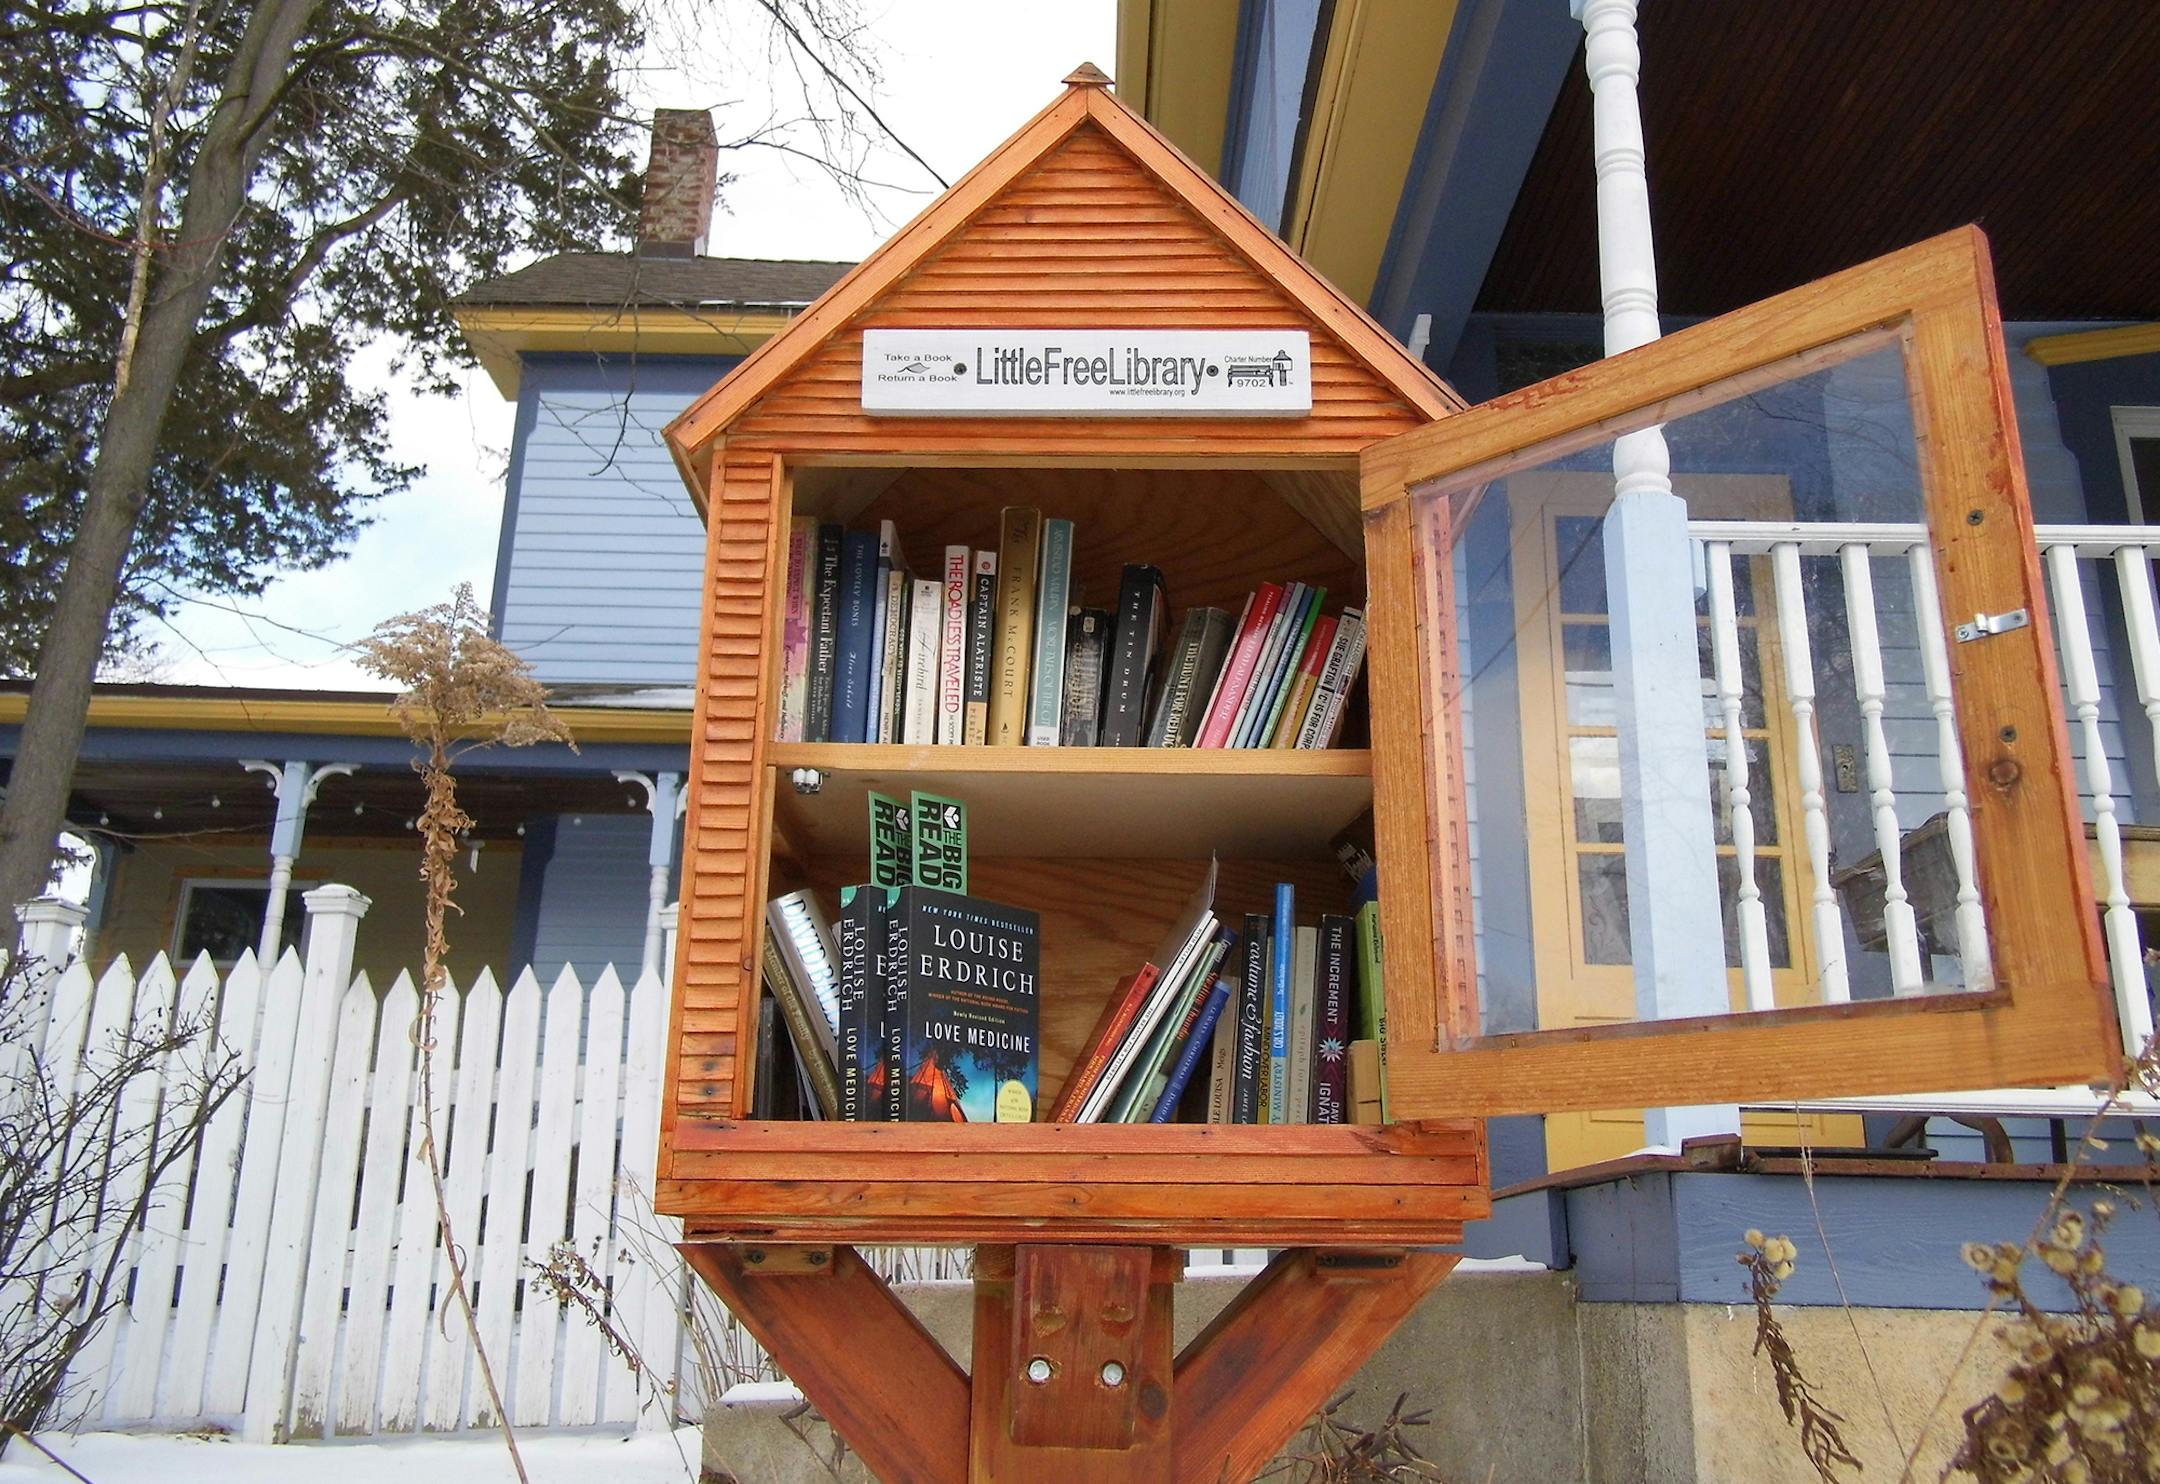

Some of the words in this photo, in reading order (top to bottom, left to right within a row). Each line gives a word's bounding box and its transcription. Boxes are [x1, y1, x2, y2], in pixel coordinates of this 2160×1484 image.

[884, 353, 910, 362] Take
[924, 353, 952, 362] Book
[976, 347, 1206, 395] LittleFreeLibrary
[1224, 355, 1247, 363] Charter
[1248, 355, 1272, 363] Number
[877, 374, 915, 382] Return
[929, 374, 958, 382] Book
[1109, 387, 1186, 396] www.littlefreelibrary.org
[1236, 379, 1266, 388] 9702
[824, 555, 838, 577] The
[855, 544, 865, 559] THE
[948, 554, 964, 580] THE
[853, 563, 863, 597] LOVELY
[1008, 567, 1022, 617] FRANK
[791, 595, 800, 614] WHEN
[819, 580, 837, 634] Expectant
[851, 600, 860, 627] BONES
[948, 581, 963, 619] ROAD
[978, 578, 990, 629] CAPTAIN
[1131, 591, 1140, 620] THE
[887, 595, 899, 657] DEMOCRACY
[946, 621, 962, 646] LESS
[1046, 621, 1059, 648] MORE
[818, 637, 833, 674] Father
[915, 631, 937, 690] Firebird
[1126, 631, 1135, 659] TIN
[1186, 642, 1199, 662] THE
[1335, 638, 1349, 652] SUE
[847, 651, 857, 675] Alice
[973, 633, 986, 697] ALATRISTE
[1003, 625, 1017, 697] McCOURT
[1045, 652, 1056, 675] TALES
[1177, 661, 1195, 690] HUNT
[1323, 651, 1344, 687] GRAFTON
[845, 679, 854, 709] Sebold
[944, 648, 961, 714] TRAVELED
[1120, 668, 1130, 713] DRUM
[1219, 666, 1245, 719] ALEXANDER
[894, 691, 902, 715] SCHOOL
[1042, 689, 1054, 710] THE
[1171, 691, 1187, 712] FOR
[1314, 703, 1325, 713] IS
[882, 712, 890, 736] HENRY
[947, 720, 955, 738] SCOTT
[1166, 712, 1181, 734] RED
[1308, 712, 1321, 728] FOR
[874, 798, 897, 887] READ
[918, 798, 943, 887] READ
[943, 830, 962, 846] THE
[896, 846, 912, 887] BIG
[942, 845, 962, 889] BIG
[780, 899, 826, 964] DAVID
[922, 905, 939, 915] NEW
[943, 909, 962, 919] YORK
[966, 914, 988, 925] TIMES
[991, 919, 1034, 936] BESTSELLER
[934, 924, 1024, 963] LOUISE
[1330, 926, 1343, 950] THE
[767, 950, 786, 986] Member
[842, 918, 855, 1012] ERDRICH
[852, 926, 866, 1001] LOUISE
[887, 919, 899, 1012] ERDRICH
[896, 927, 908, 1001] LOUISE
[920, 953, 1034, 996] ERDRICH
[1246, 941, 1262, 1002] costume
[1196, 972, 1217, 1005] Stealing
[1327, 953, 1342, 1025] INCREMENT
[953, 1010, 968, 1019] Newly
[968, 1012, 987, 1022] Revised
[988, 1015, 1006, 1025] Edition
[1145, 1007, 1154, 1019] THE
[1177, 1008, 1200, 1040] Thunder
[1246, 1002, 1262, 1024] &
[846, 1027, 858, 1061] LOVE
[891, 1027, 902, 1061] LOVE
[925, 1021, 961, 1043] LOVE
[967, 1027, 1031, 1054] MEDICINE
[1131, 1018, 1146, 1041] REASON
[1262, 1026, 1271, 1051] MIND
[1297, 1025, 1305, 1064] epitaph
[1123, 1041, 1133, 1053] FOR
[1216, 1048, 1227, 1070] Meigs
[1241, 1018, 1262, 1080] fashion
[1106, 1057, 1122, 1081] FLOWER
[1260, 1052, 1270, 1077] OVER
[1296, 1068, 1305, 1079] for
[1214, 1078, 1223, 1113] LOUISA
[1259, 1077, 1269, 1108] LABOR
[1273, 1062, 1283, 1111] MINISTRY
[1318, 1081, 1332, 1124] IGNAT
